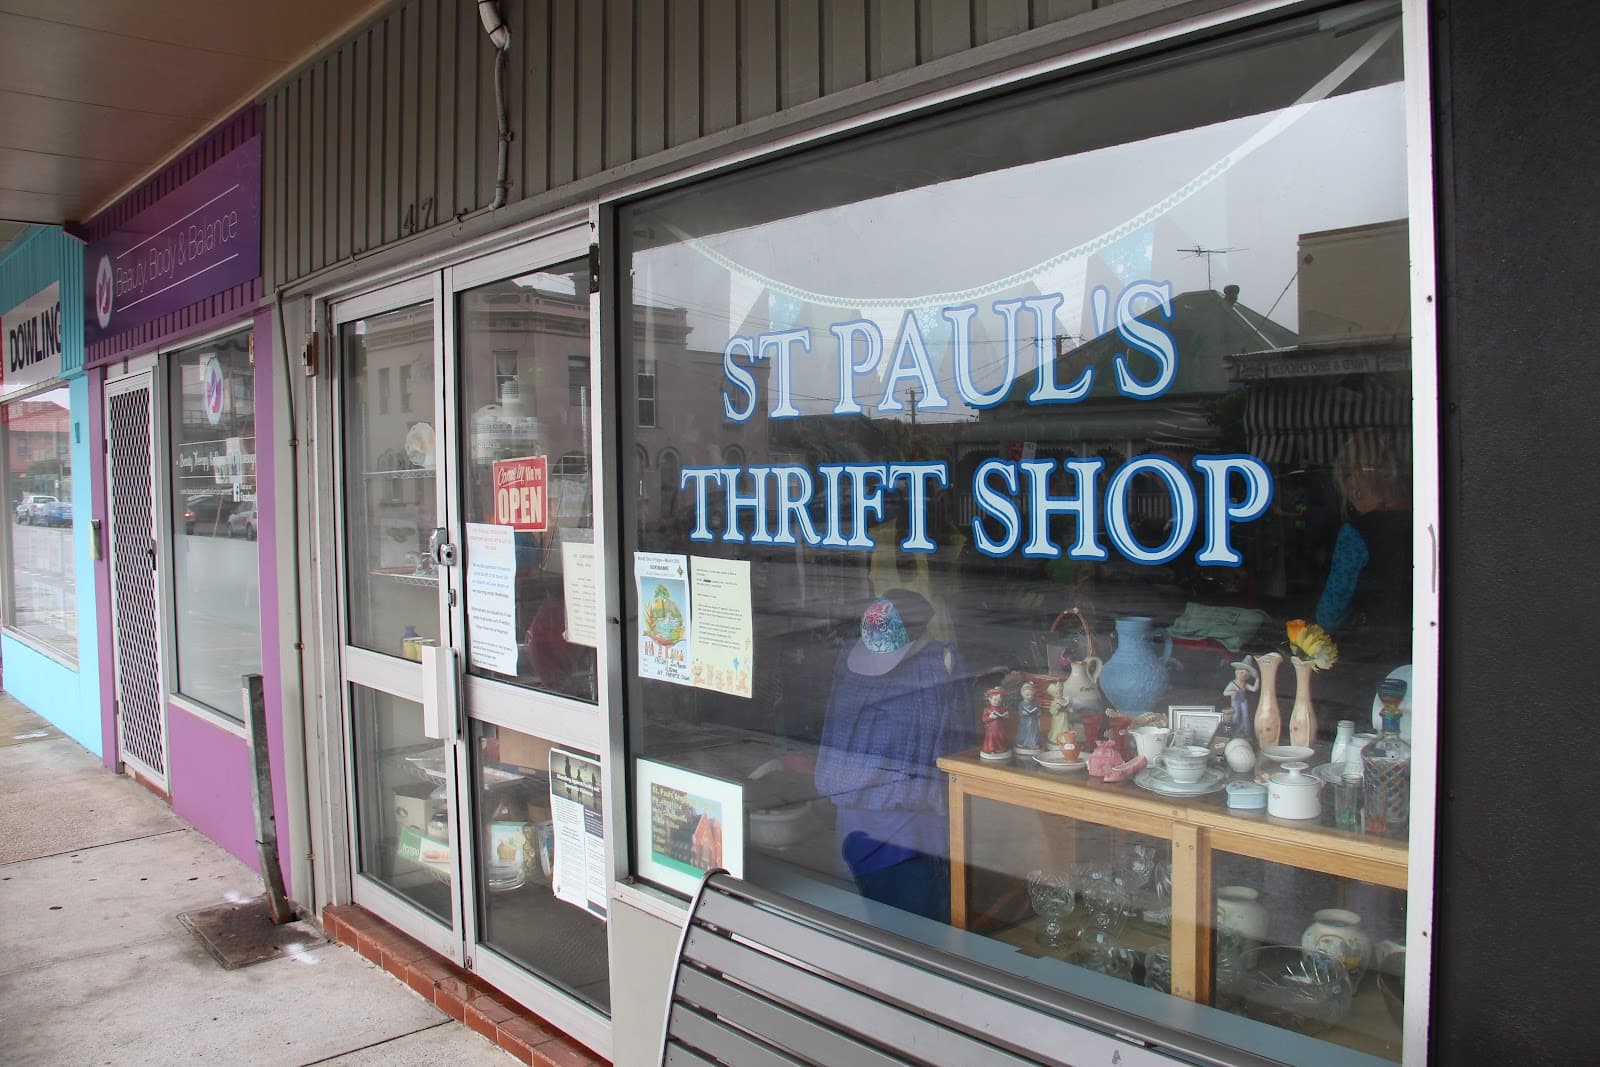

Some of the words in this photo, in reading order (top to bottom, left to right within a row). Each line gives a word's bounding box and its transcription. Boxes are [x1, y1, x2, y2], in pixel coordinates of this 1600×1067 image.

[150, 238, 176, 281] Body
[178, 231, 187, 266] &
[188, 210, 238, 261] Balance
[722, 328, 811, 423] ST
[829, 279, 1179, 417] PAUL'S
[498, 486, 542, 524] OPEN
[680, 461, 949, 552] THRIFT
[972, 454, 1272, 567] SHOP
